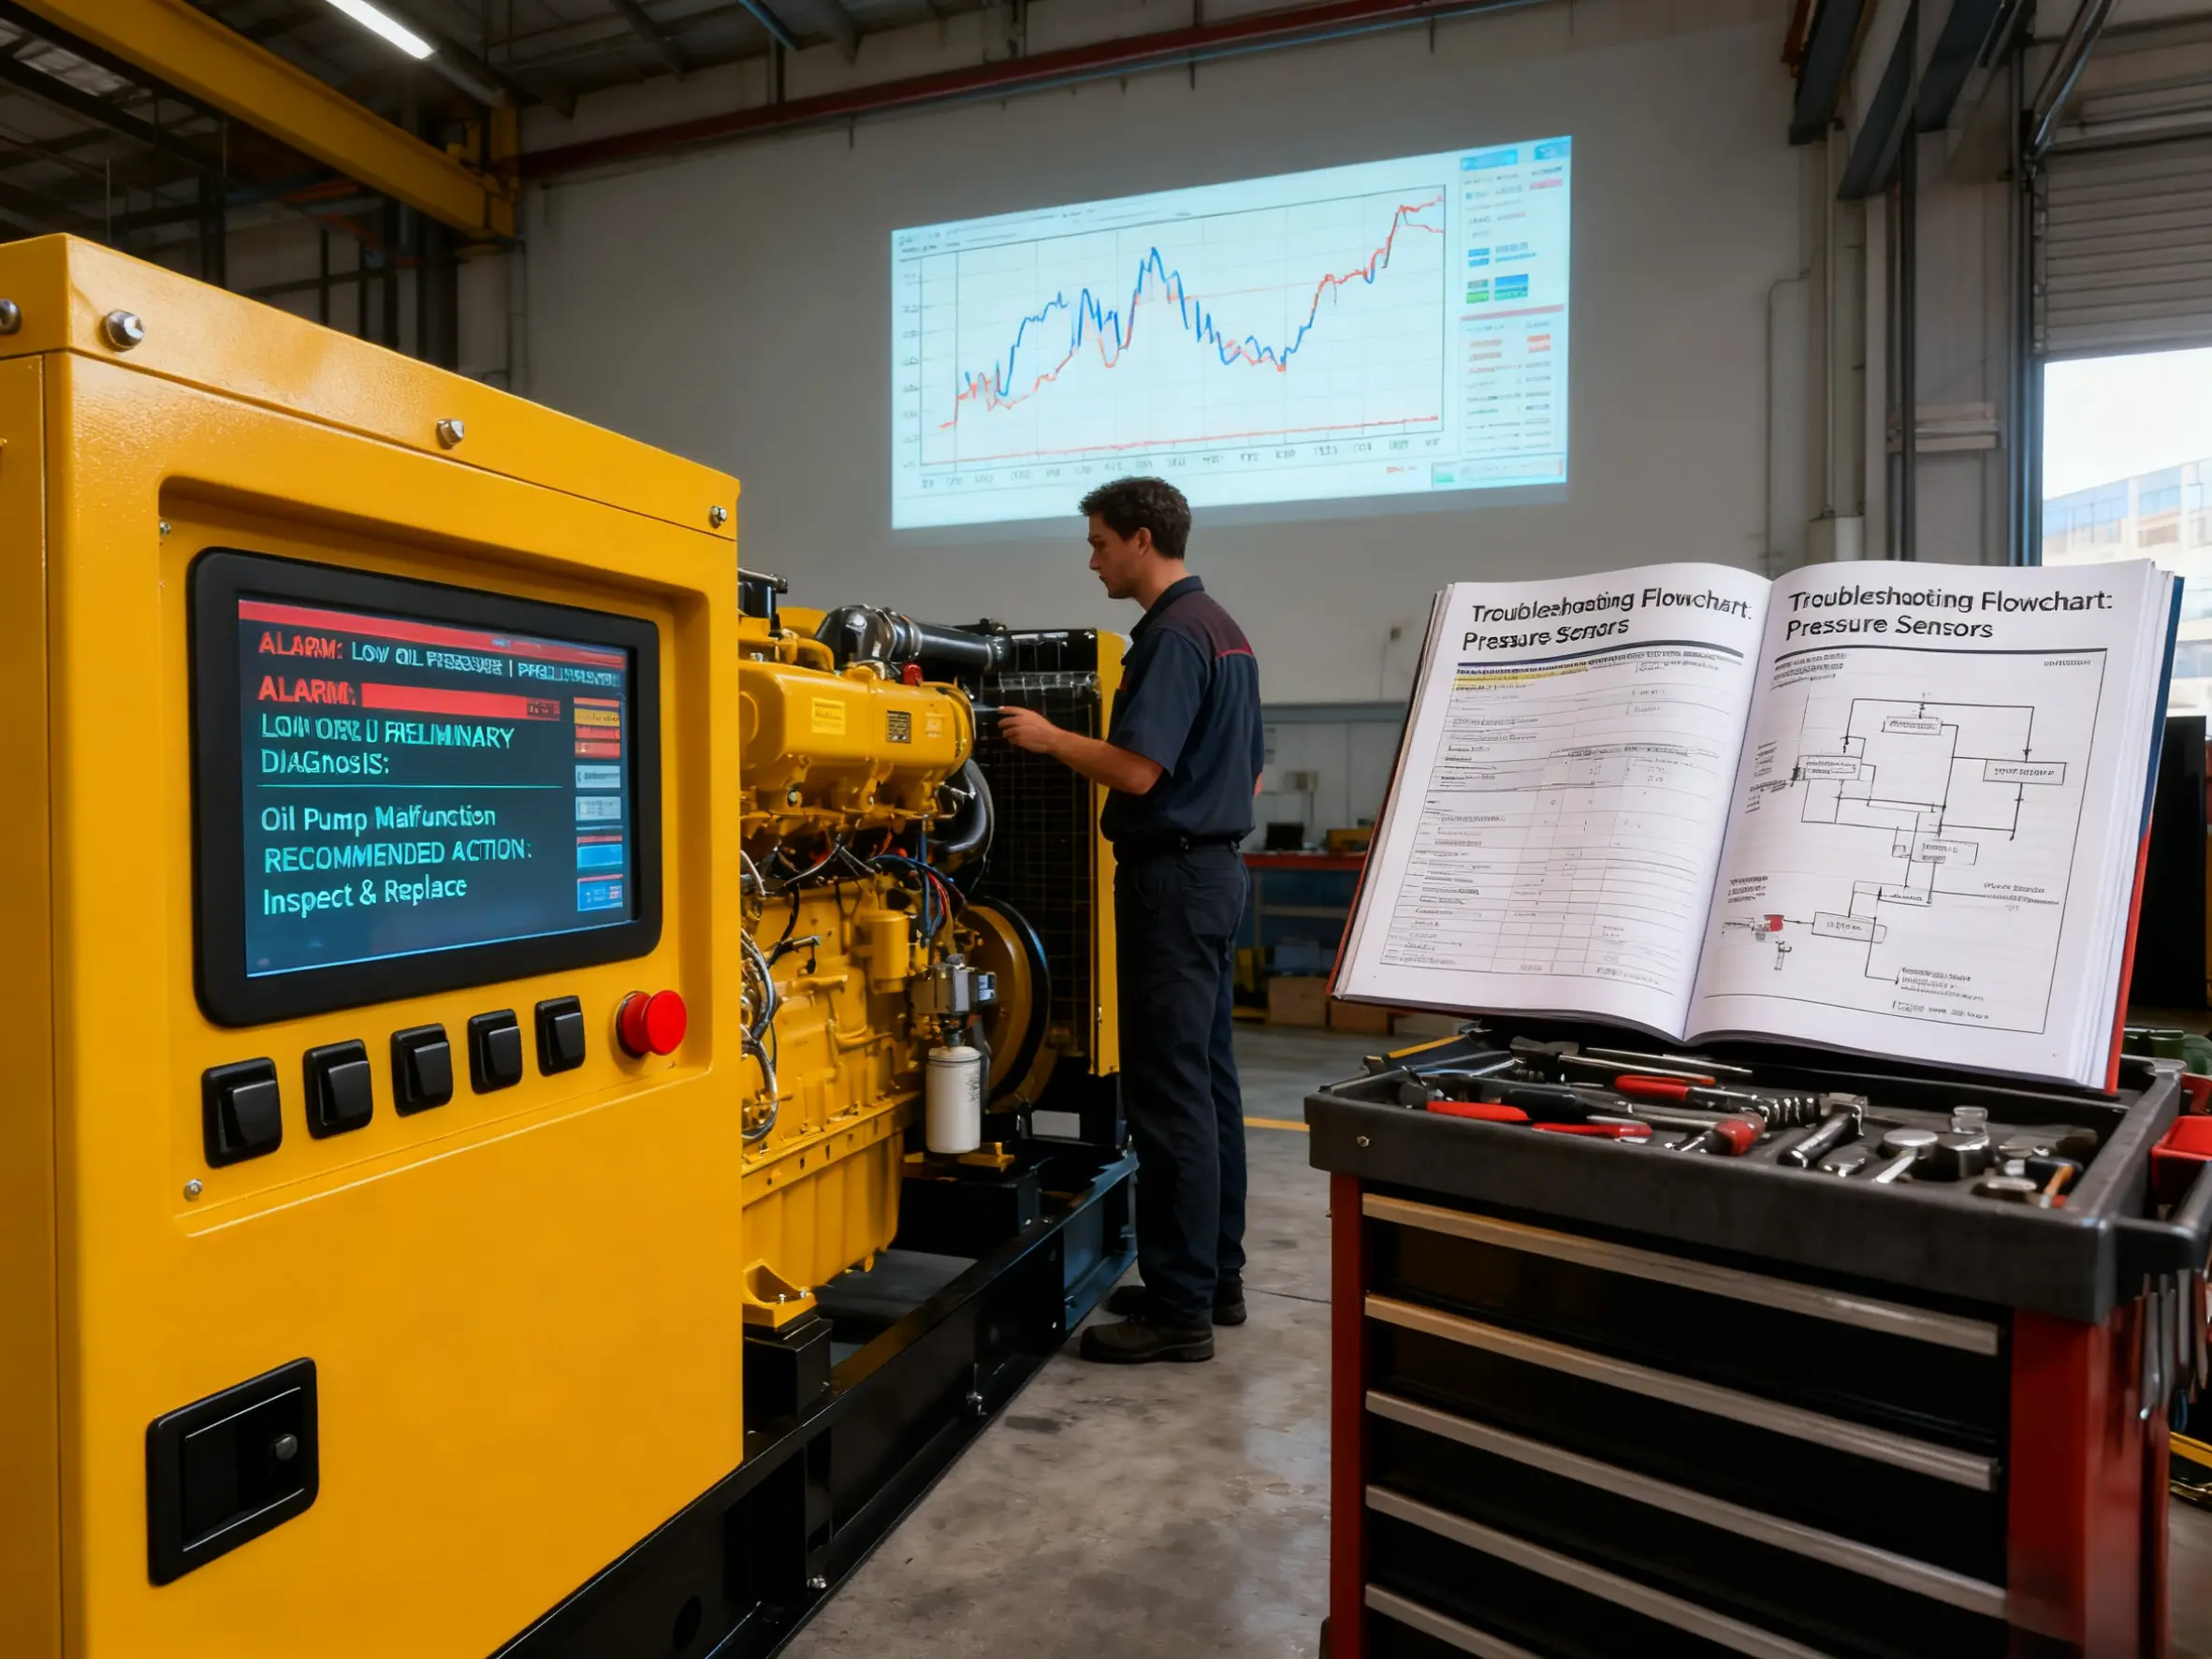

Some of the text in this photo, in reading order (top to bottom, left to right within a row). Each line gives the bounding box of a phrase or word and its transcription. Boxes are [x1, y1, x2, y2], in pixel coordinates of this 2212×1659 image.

[1788, 585, 2114, 613] Troubleshooting Flowchart:
[1786, 615, 1993, 641] Pressure Sensors
[261, 805, 496, 837] Oil Pump Malfunction
[264, 838, 532, 873] RECOMMENDED ACTION:
[264, 874, 468, 918] Inspect & Replace
